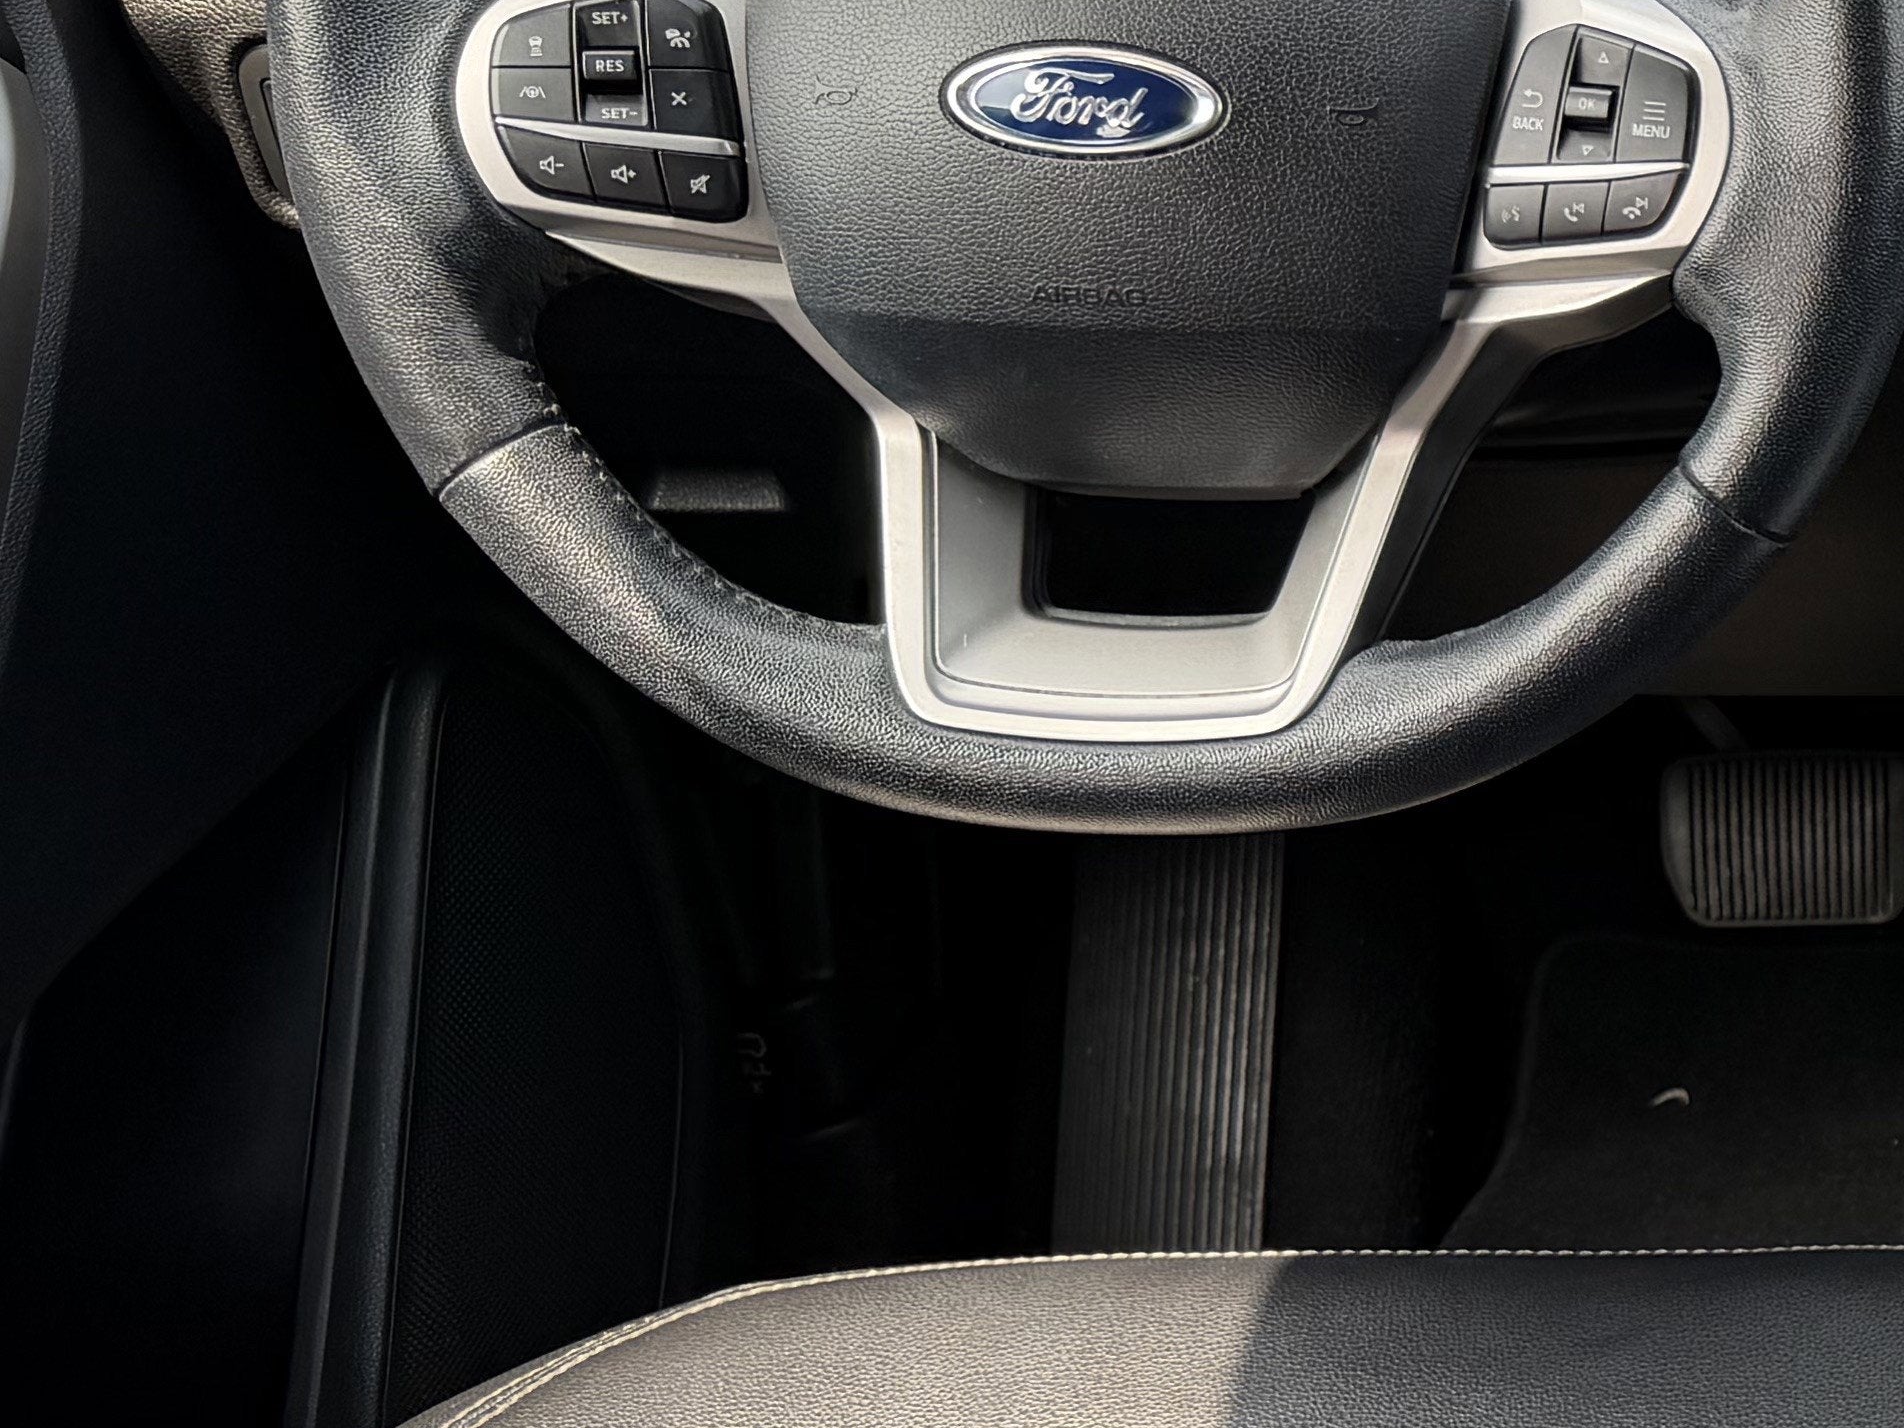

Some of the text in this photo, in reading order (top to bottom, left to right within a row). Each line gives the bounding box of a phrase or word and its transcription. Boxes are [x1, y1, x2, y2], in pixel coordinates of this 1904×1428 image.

[595, 59, 625, 72] RES
[1010, 67, 1149, 138] Ford
[1578, 97, 1596, 110] OK
[1512, 115, 1545, 131] BACK
[1631, 123, 1671, 139] MENU
